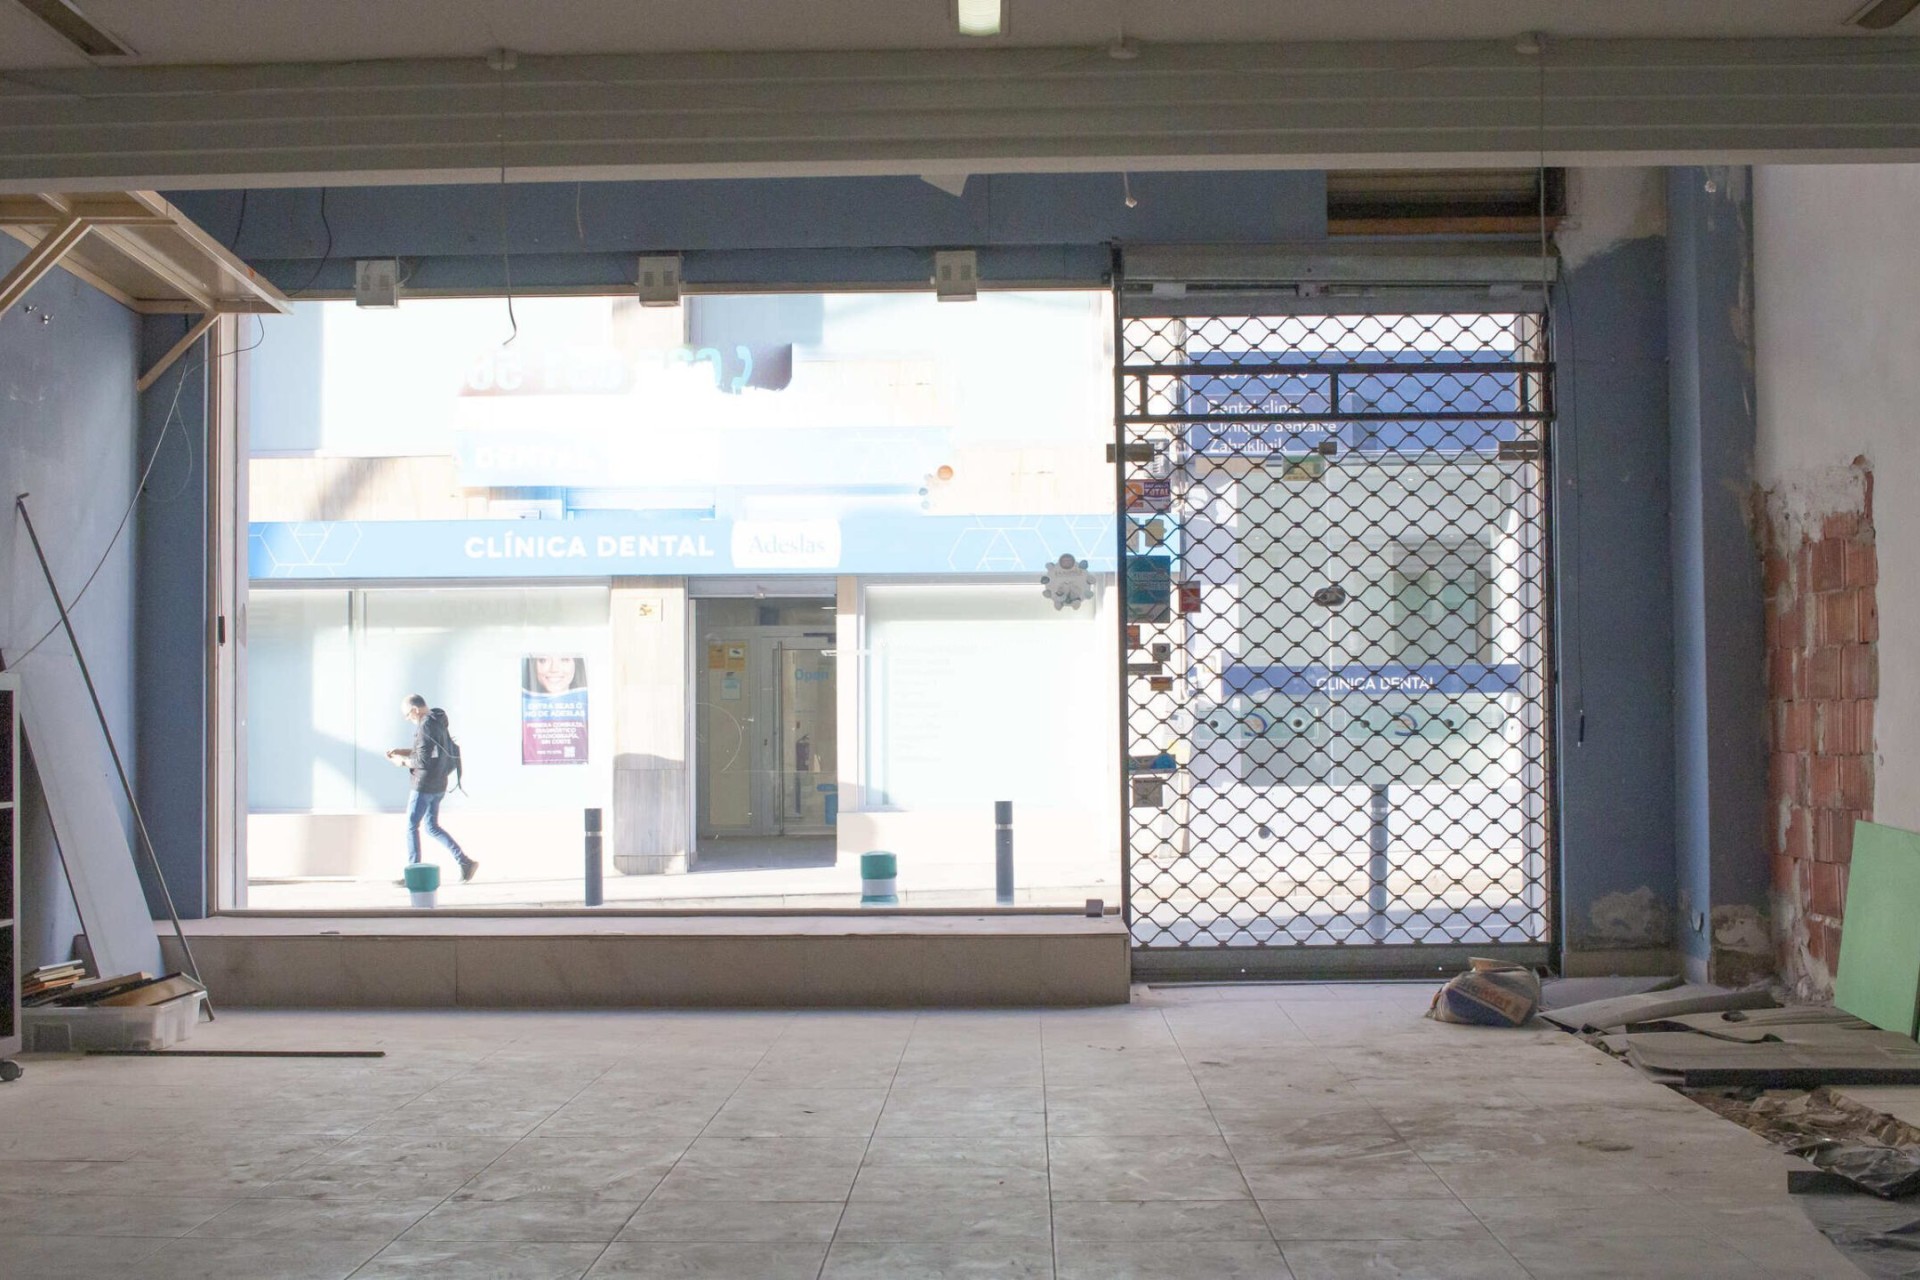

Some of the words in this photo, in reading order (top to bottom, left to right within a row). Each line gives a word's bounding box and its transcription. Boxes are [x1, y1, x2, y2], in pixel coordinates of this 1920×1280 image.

[1207, 399, 1258, 415] Dental
[1264, 399, 1303, 415] clinic
[1208, 437, 1287, 453] Zahnklinik
[464, 530, 588, 560] CLÍNICA
[596, 534, 715, 559] DENTAL
[747, 533, 826, 555] Adeslas
